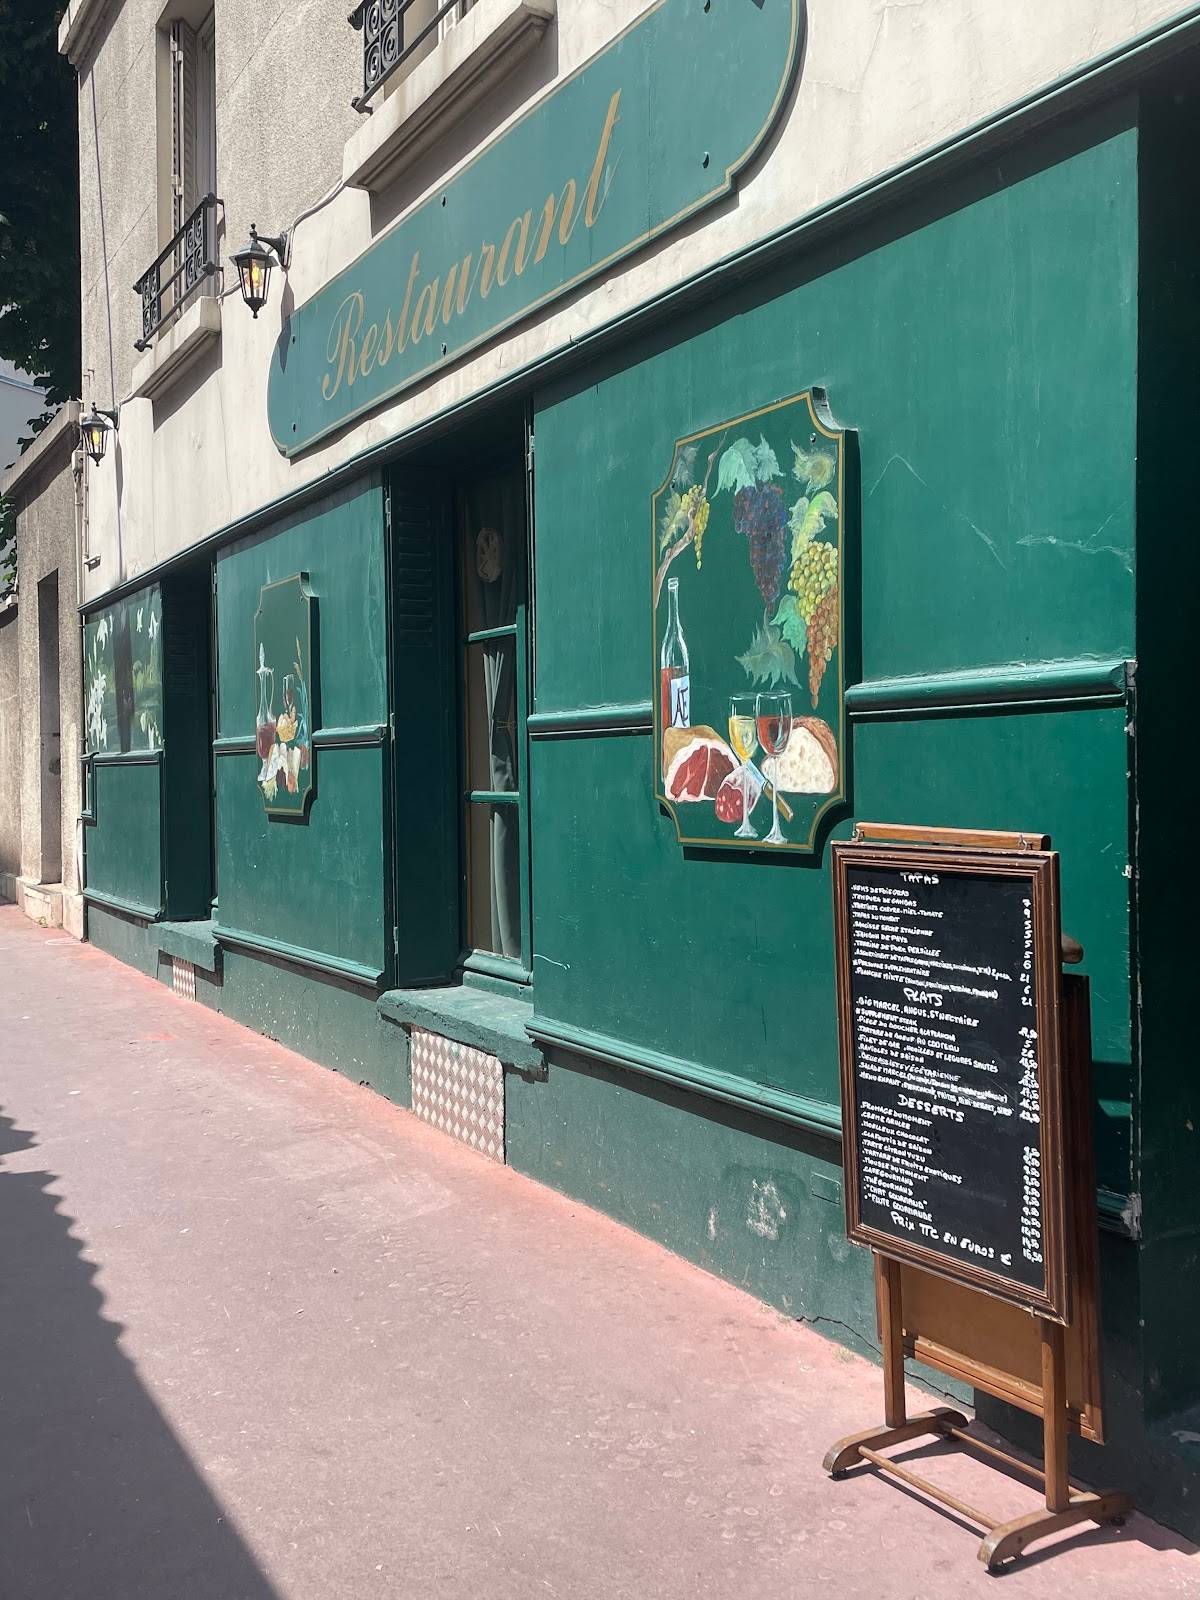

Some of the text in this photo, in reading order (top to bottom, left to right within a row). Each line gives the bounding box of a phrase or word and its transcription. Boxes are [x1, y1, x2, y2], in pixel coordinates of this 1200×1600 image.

[322, 88, 622, 401] Restaurant
[900, 871, 940, 885] TAPAS
[1023, 908, 1031, 919] 9
[1023, 920, 1032, 930] 5
[1023, 929, 1033, 939] 5
[1024, 939, 1033, 948] 5
[1023, 950, 1034, 959] 5
[1022, 960, 1032, 970] 6
[1020, 973, 1030, 984] 21
[1023, 985, 1032, 995] 6
[858, 995, 872, 1006] BIG
[903, 986, 943, 1007] PLATS
[1021, 996, 1033, 1007] 21
[1024, 1040, 1033, 1049] 5
[897, 1094, 964, 1122] DESSERTS
[919, 1222, 940, 1240] TTC
[943, 1231, 958, 1246] EN
[960, 1237, 995, 1259] EUROS
